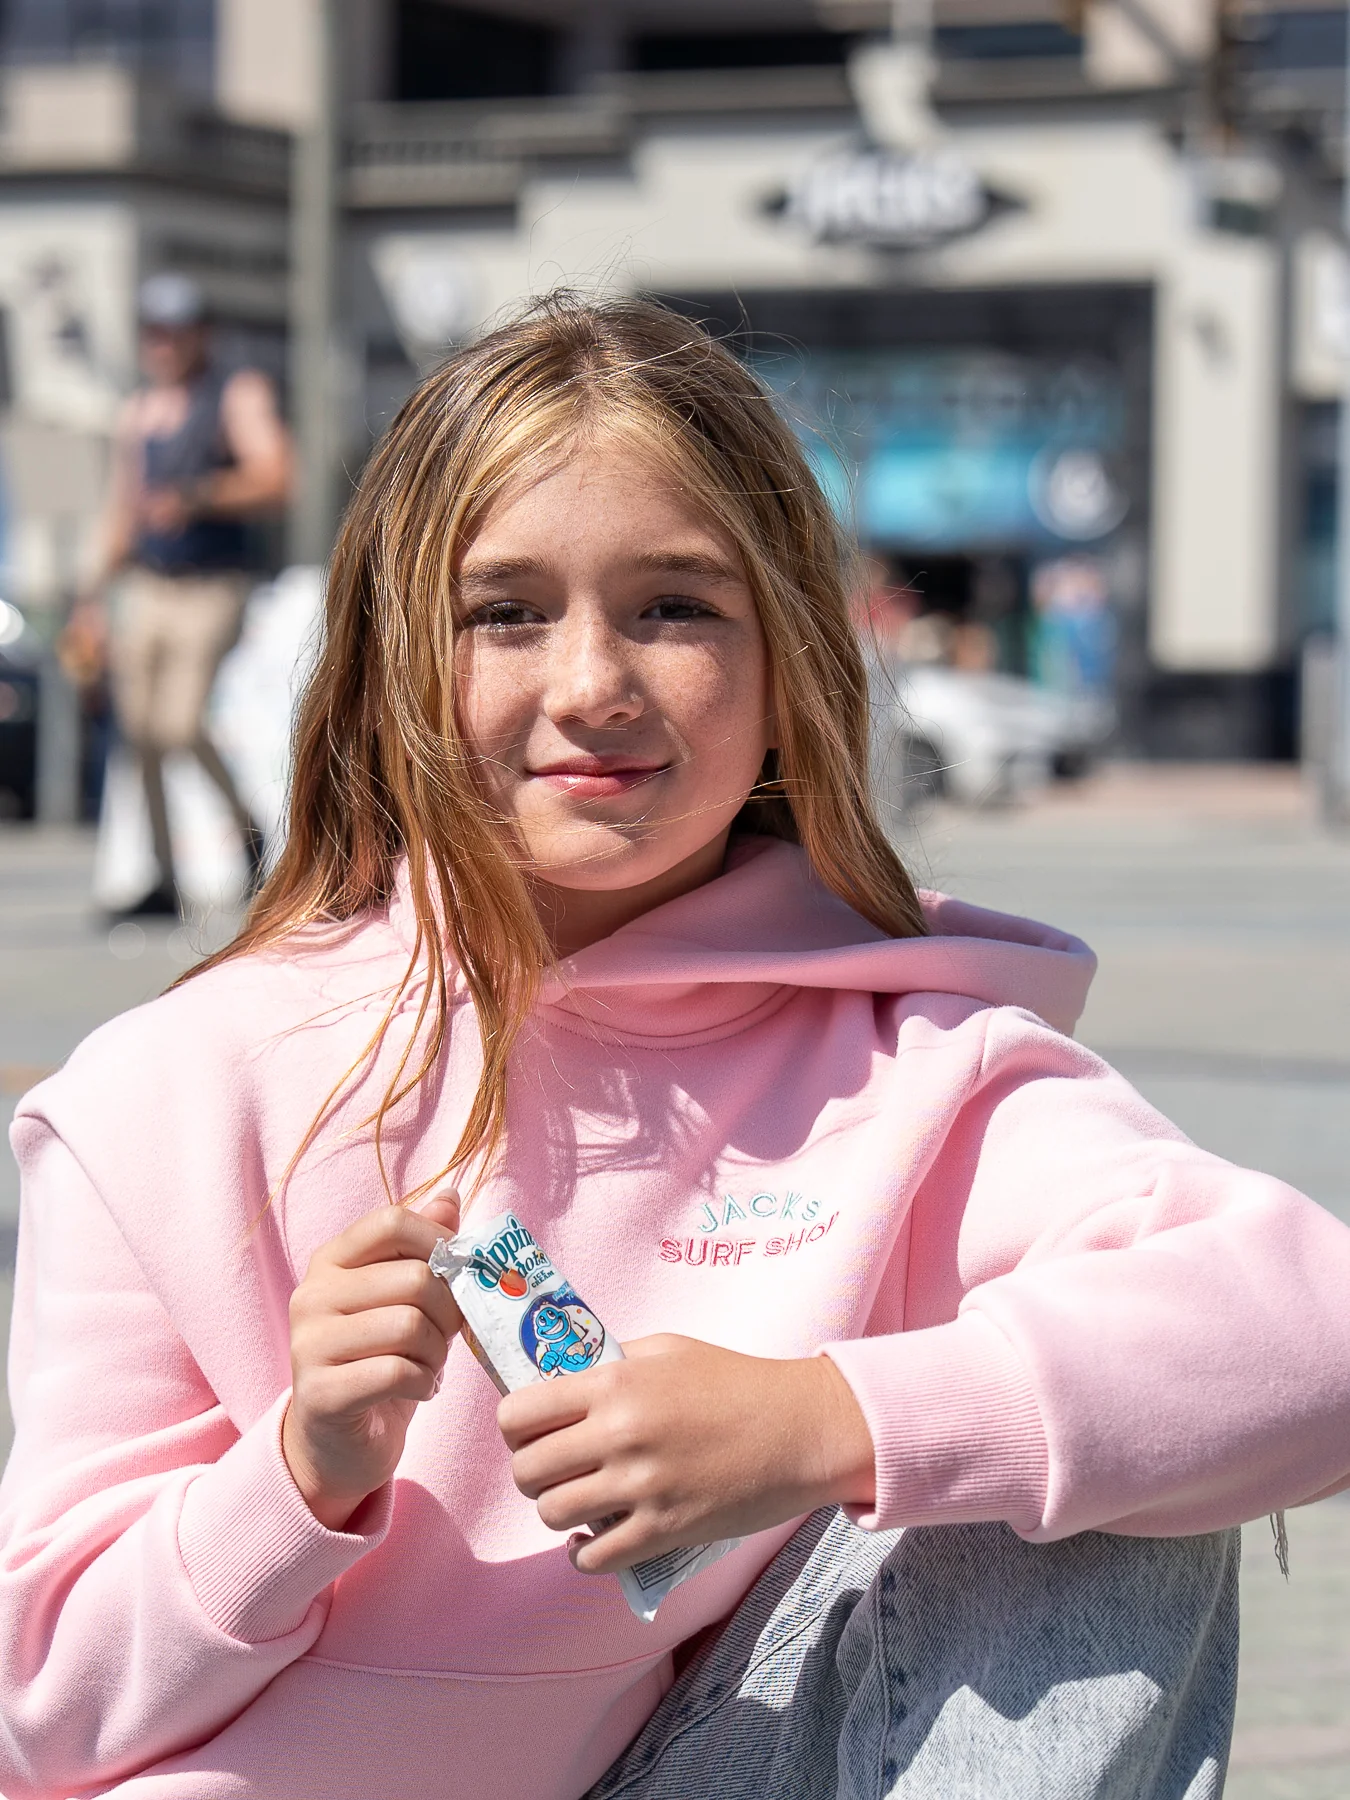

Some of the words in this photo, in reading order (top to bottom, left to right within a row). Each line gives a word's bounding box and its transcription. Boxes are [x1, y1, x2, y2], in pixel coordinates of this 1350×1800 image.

[698, 1191, 822, 1233] JACKS
[658, 1237, 756, 1267] SURF
[531, 1270, 555, 1288] CREAM
[533, 1269, 546, 1281] ICE
